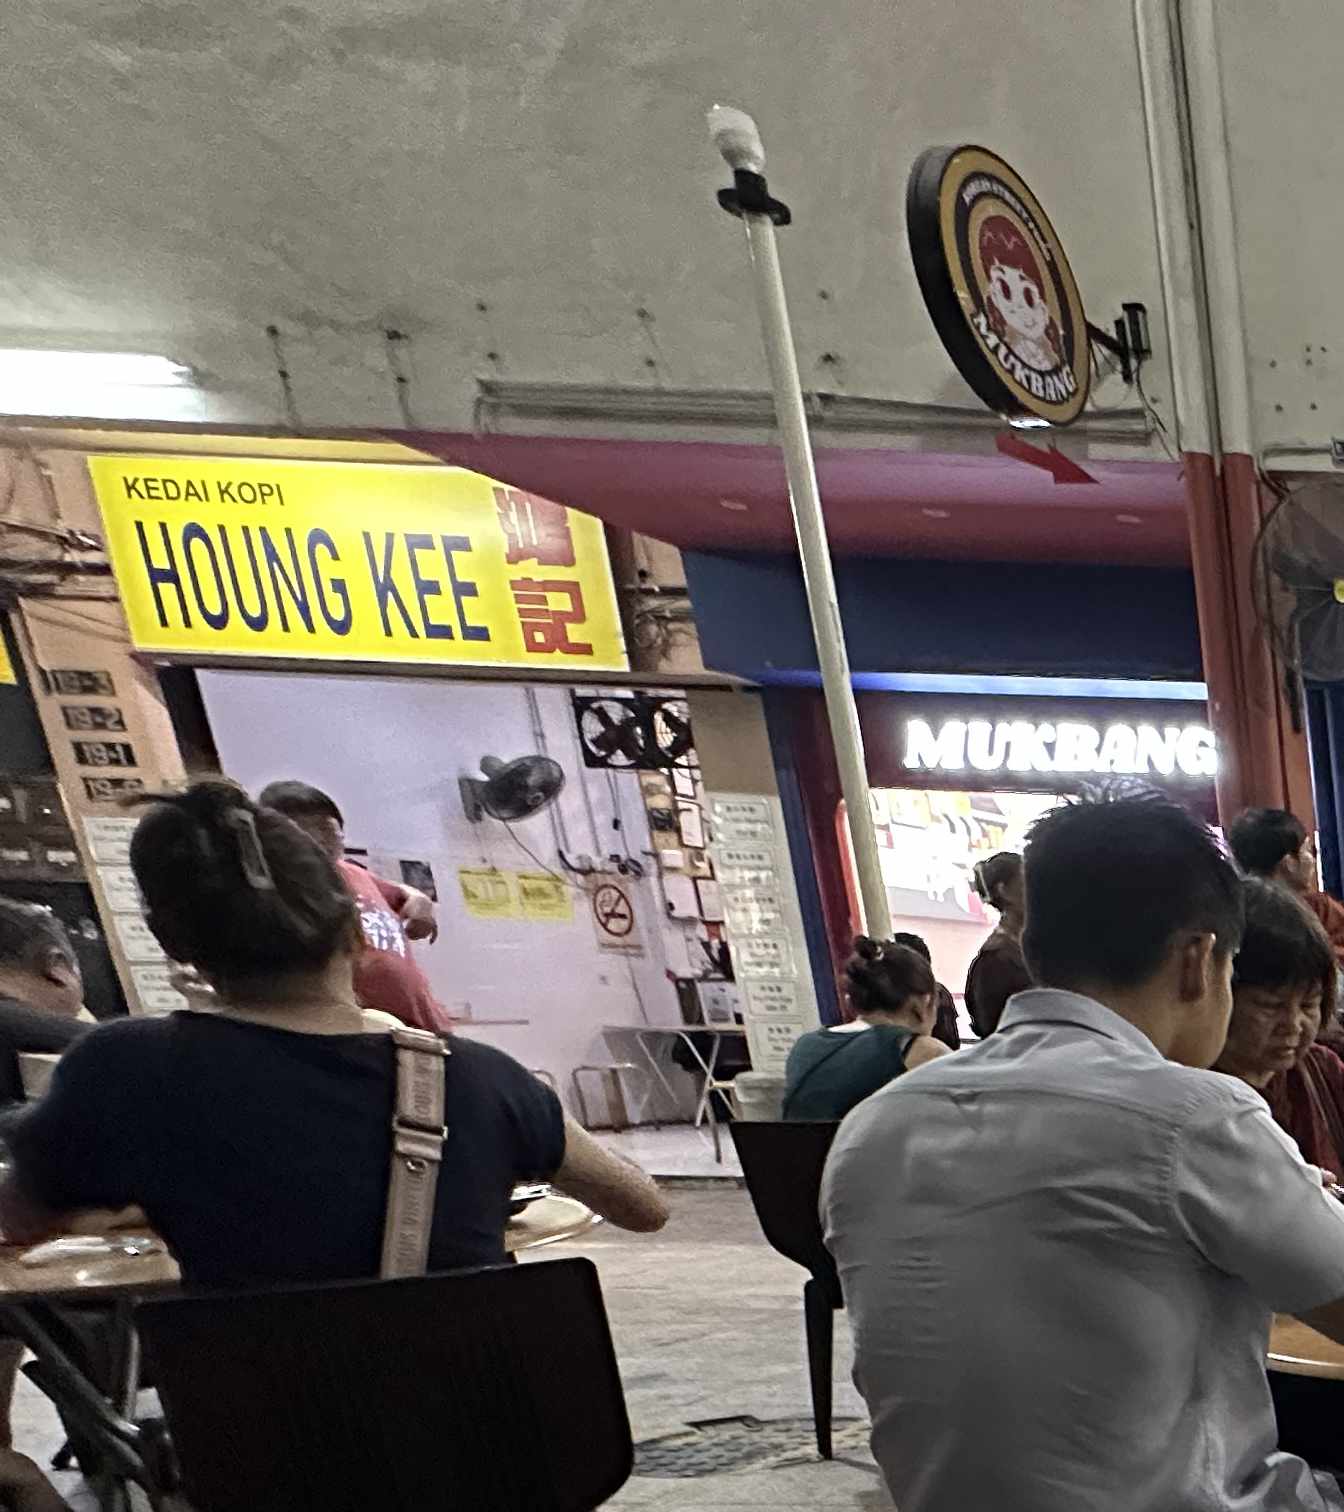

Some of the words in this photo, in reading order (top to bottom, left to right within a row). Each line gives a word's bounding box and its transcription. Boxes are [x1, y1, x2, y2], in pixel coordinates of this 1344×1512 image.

[973, 313, 1079, 402] MUKBANG
[123, 477, 209, 502] KEDAI
[218, 480, 285, 507] KOPI
[133, 520, 352, 637] HOUNG
[362, 530, 492, 643] KEE
[901, 718, 1218, 776] MUKBANG
